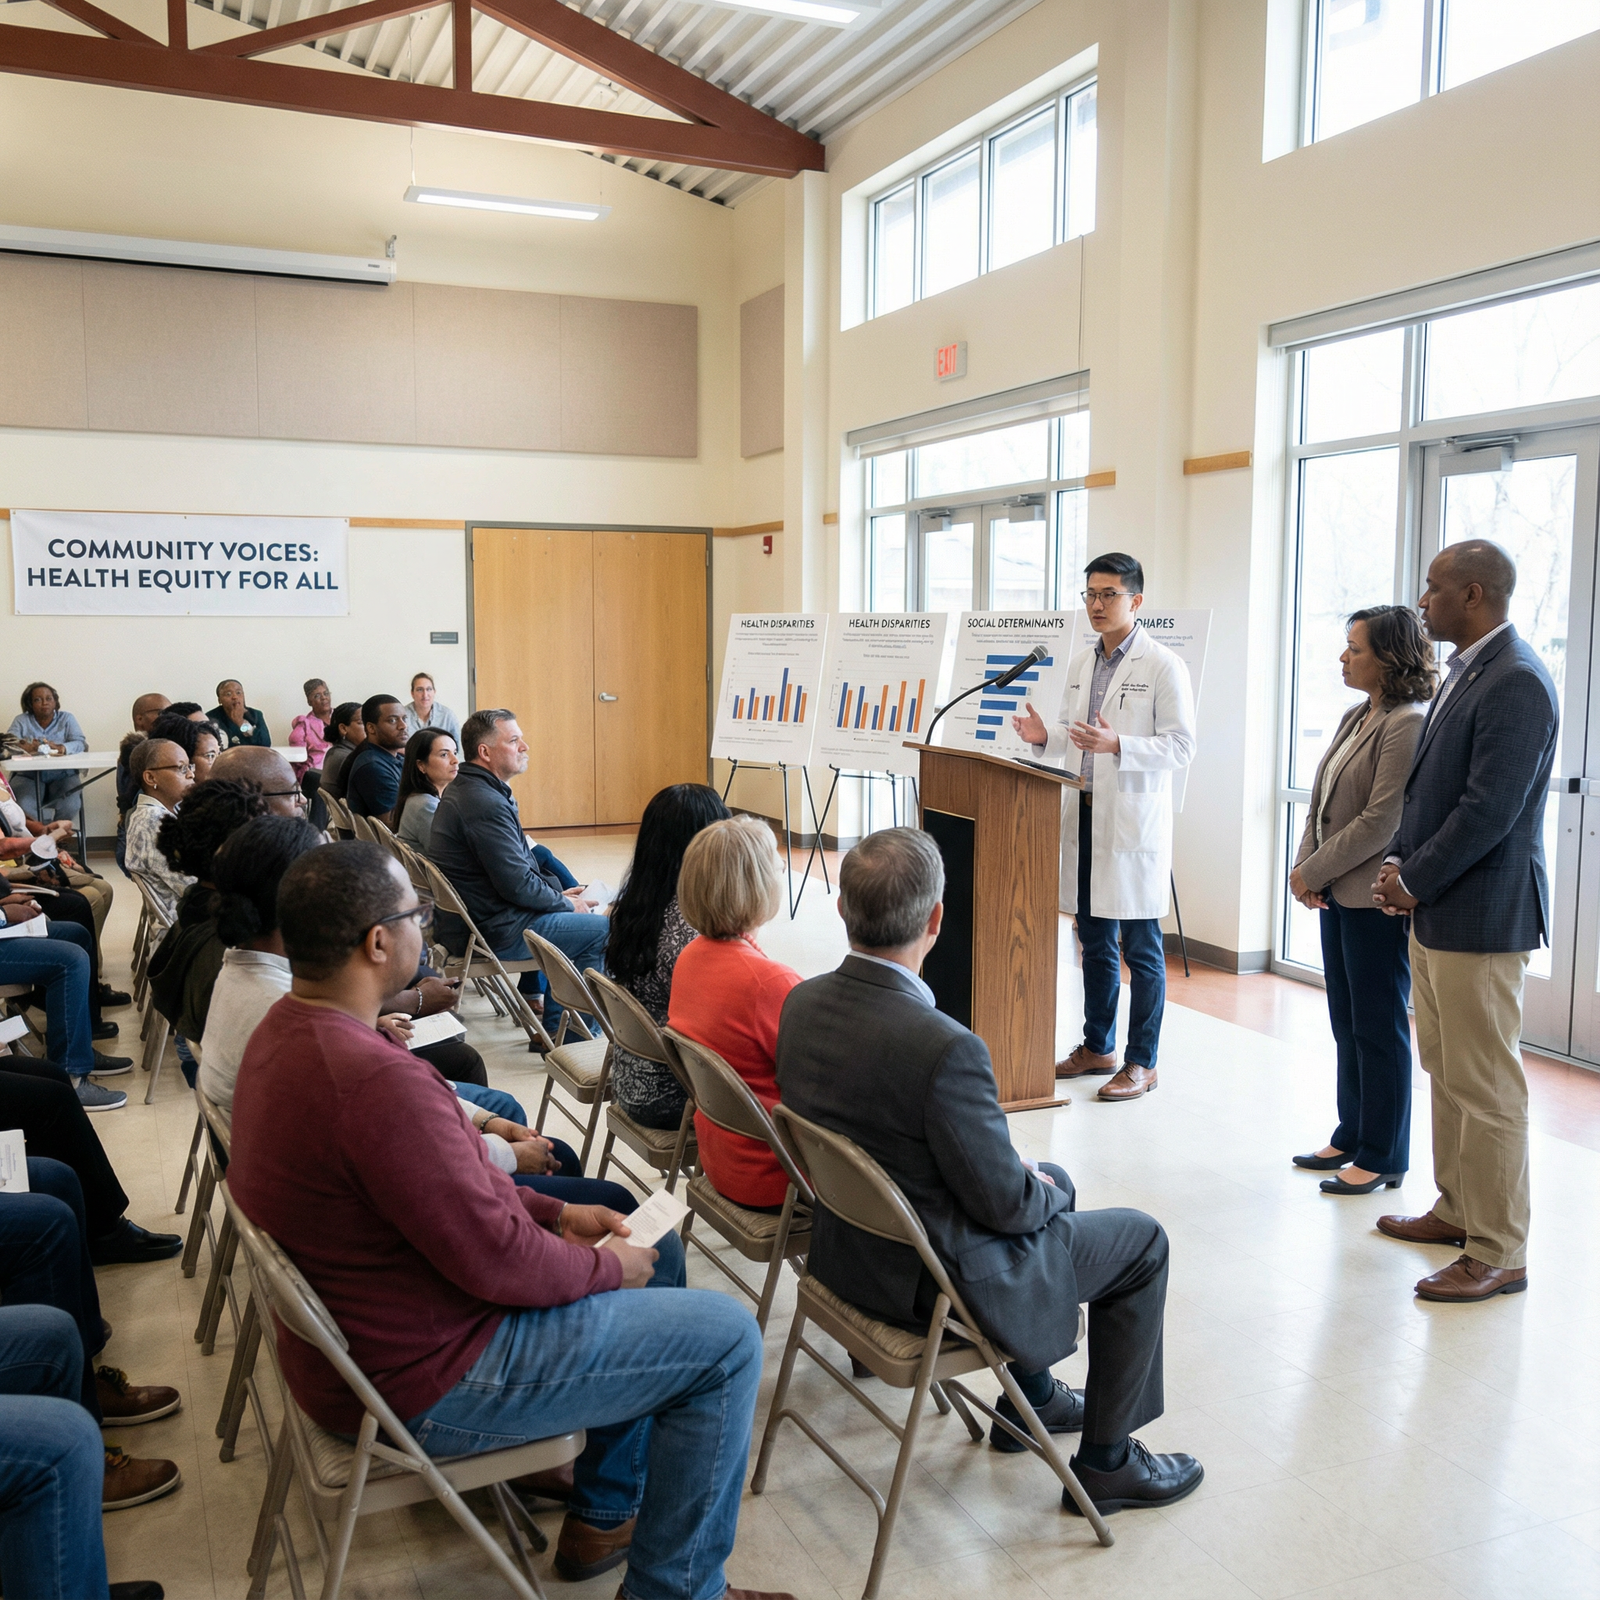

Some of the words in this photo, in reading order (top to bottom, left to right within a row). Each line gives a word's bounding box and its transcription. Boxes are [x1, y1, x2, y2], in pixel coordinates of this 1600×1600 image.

[937, 343, 957, 377] EXIT
[48, 538, 214, 560] COMMUNITY
[220, 542, 319, 562] VOICES:
[27, 567, 129, 588] HEALTH
[138, 569, 232, 593] EQUITY
[239, 571, 288, 590] FOR
[295, 572, 339, 590] ALL
[741, 619, 769, 628] HEALTH
[770, 619, 815, 629] DISPARITIES
[849, 619, 880, 628] HEALTH
[881, 619, 931, 629] DISPARITIES
[967, 618, 996, 628] SOCIAL
[997, 618, 1065, 628] DETERMINANTS
